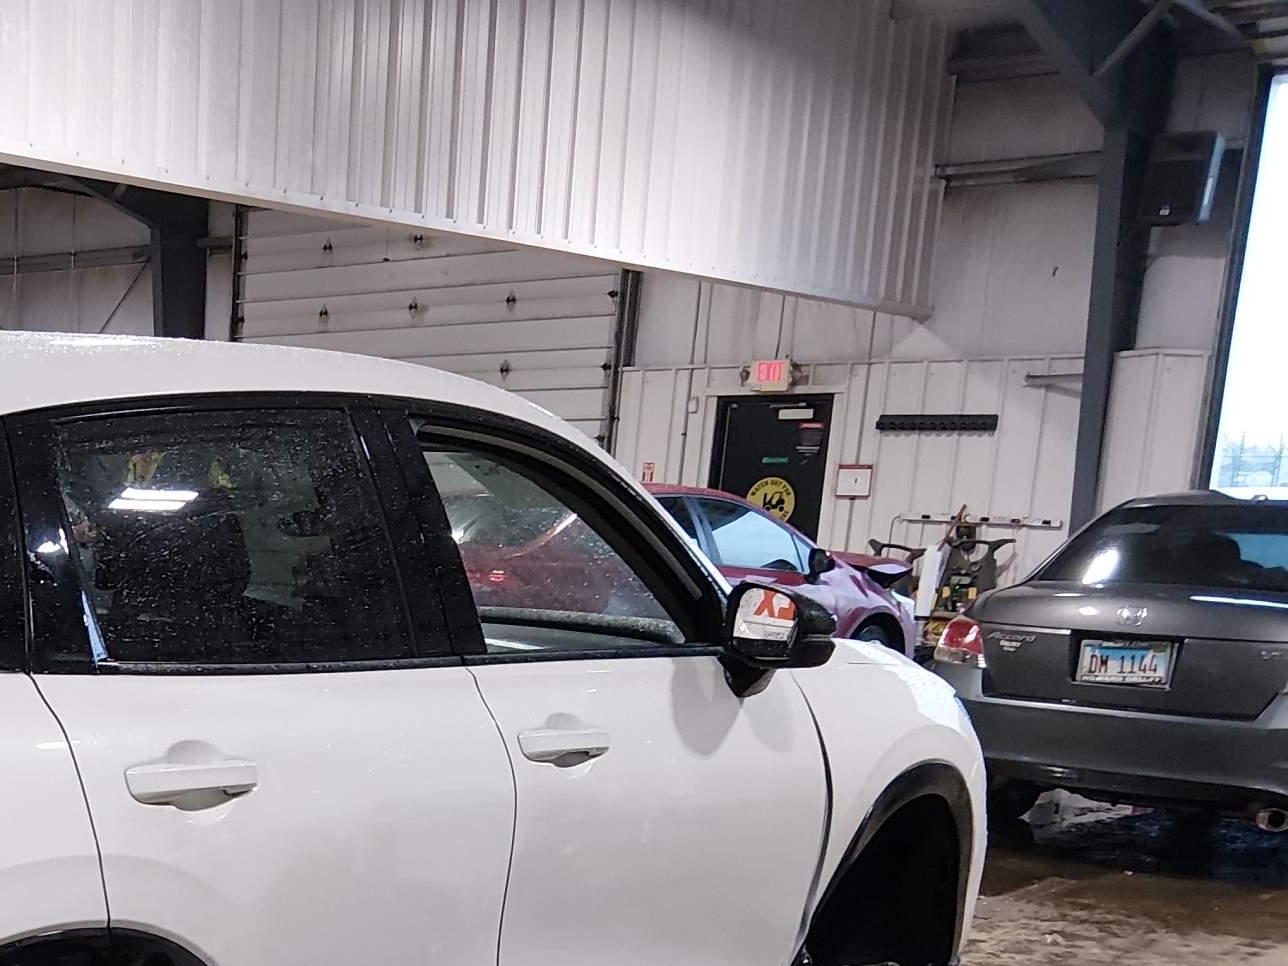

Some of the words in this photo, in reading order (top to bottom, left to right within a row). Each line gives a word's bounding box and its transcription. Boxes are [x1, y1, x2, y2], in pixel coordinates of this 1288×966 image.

[757, 362, 785, 382] EXIT
[986, 631, 1037, 643] Accord
[1088, 653, 1110, 674] DM
[1116, 653, 1158, 674] 1144
